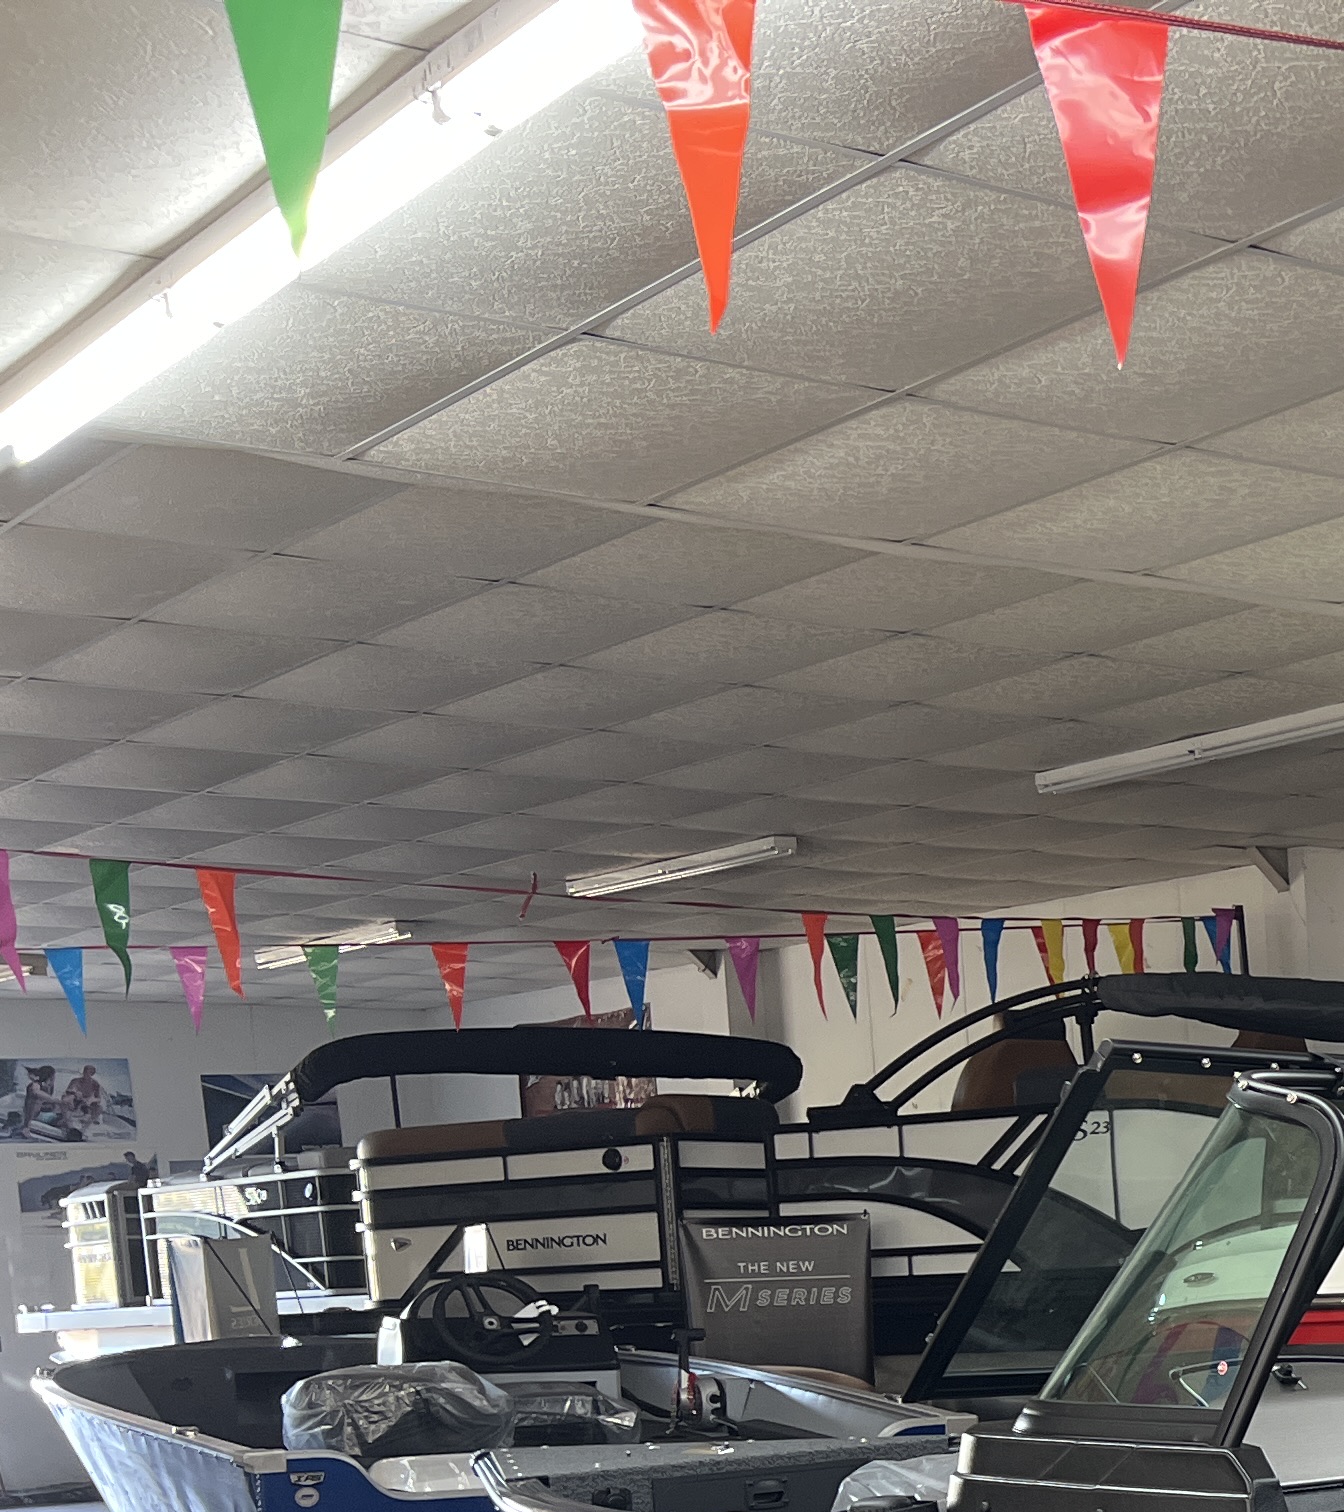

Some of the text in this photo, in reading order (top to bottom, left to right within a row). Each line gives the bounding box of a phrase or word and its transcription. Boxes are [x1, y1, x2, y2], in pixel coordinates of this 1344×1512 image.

[702, 1223, 848, 1240] BENNINGTON
[506, 1233, 607, 1251] BENNINGTON
[737, 1260, 815, 1274] THE NEW
[706, 1284, 852, 1313] M SERIES
